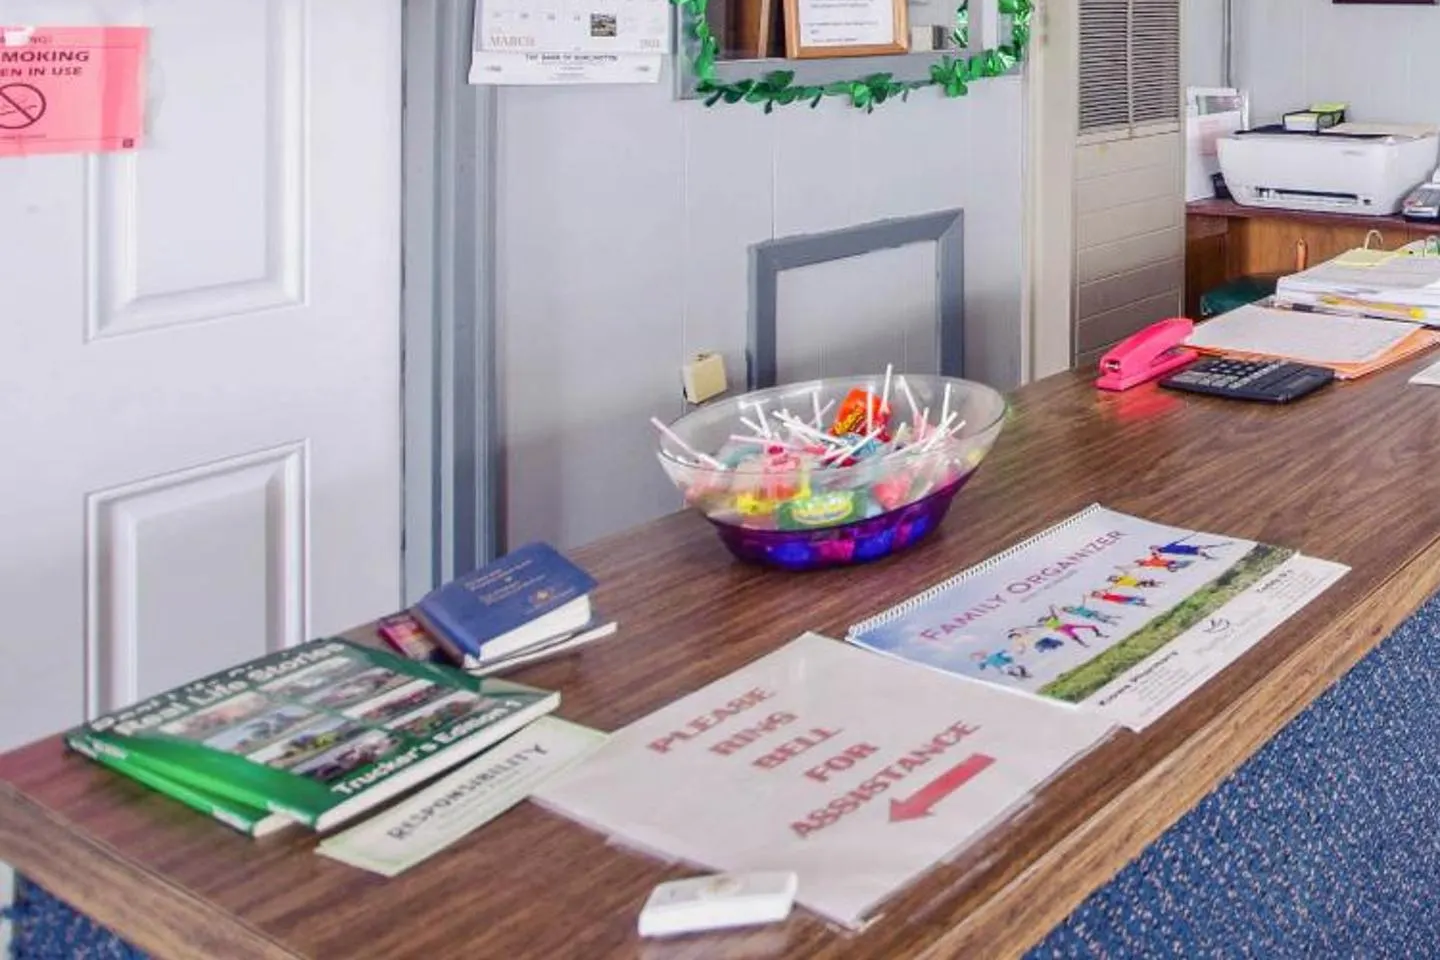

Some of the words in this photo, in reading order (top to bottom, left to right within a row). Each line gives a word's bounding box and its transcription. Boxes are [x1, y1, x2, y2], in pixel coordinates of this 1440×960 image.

[0, 50, 90, 63] MOKING
[490, 36, 535, 48] MARCH
[28, 66, 46, 76] IN
[52, 66, 83, 76] USE
[919, 593, 1008, 642] FAMILY
[1006, 530, 1129, 595] ORGANIZER
[114, 702, 190, 735] Real
[187, 680, 249, 706] Life
[248, 642, 346, 681] Stories
[645, 686, 777, 754] PLEASE
[708, 711, 799, 755] RING
[331, 743, 438, 795] Trucker's
[752, 728, 845, 769] BELL
[804, 742, 881, 783] FOR
[387, 744, 549, 840] RESPONSIBILITY
[790, 720, 982, 839] ASSISTANCE
